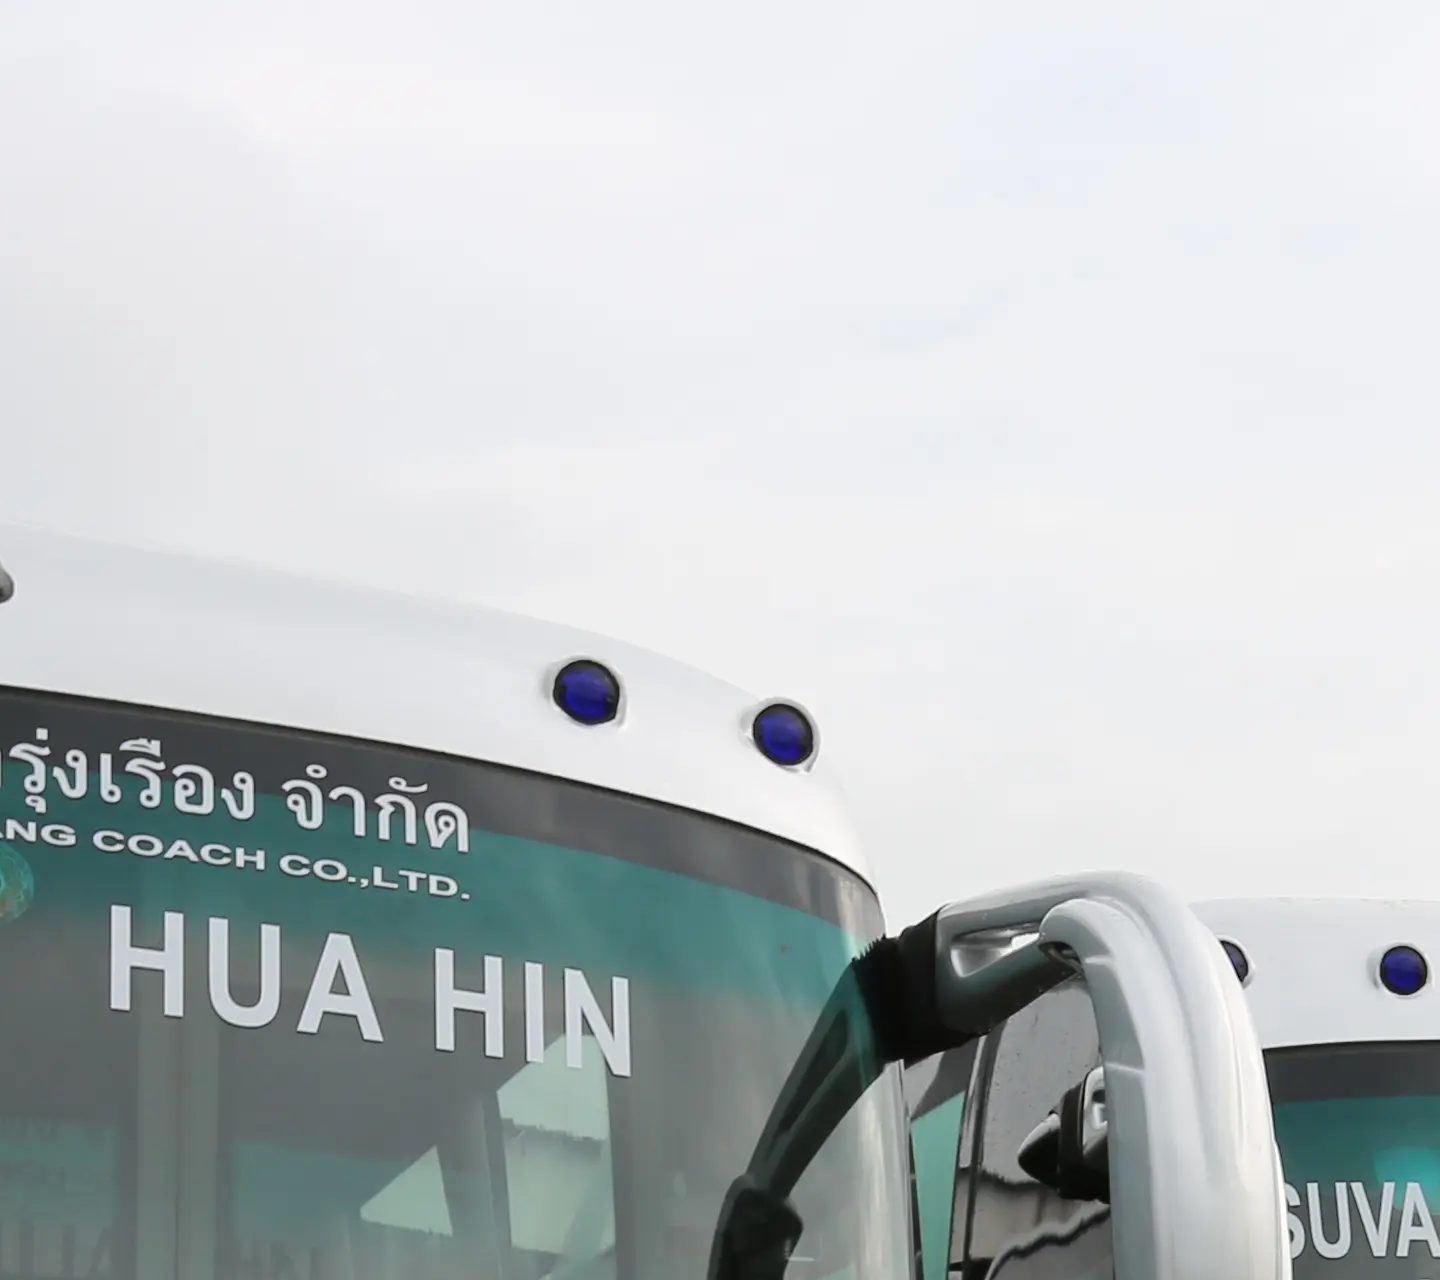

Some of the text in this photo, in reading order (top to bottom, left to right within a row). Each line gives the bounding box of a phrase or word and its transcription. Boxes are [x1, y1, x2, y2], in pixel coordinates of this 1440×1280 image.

[283, 766, 470, 853] จำกัด
[91, 831, 266, 870] COACH
[279, 855, 471, 900] CO.,LTD.
[108, 904, 632, 1078] HUA HIN
